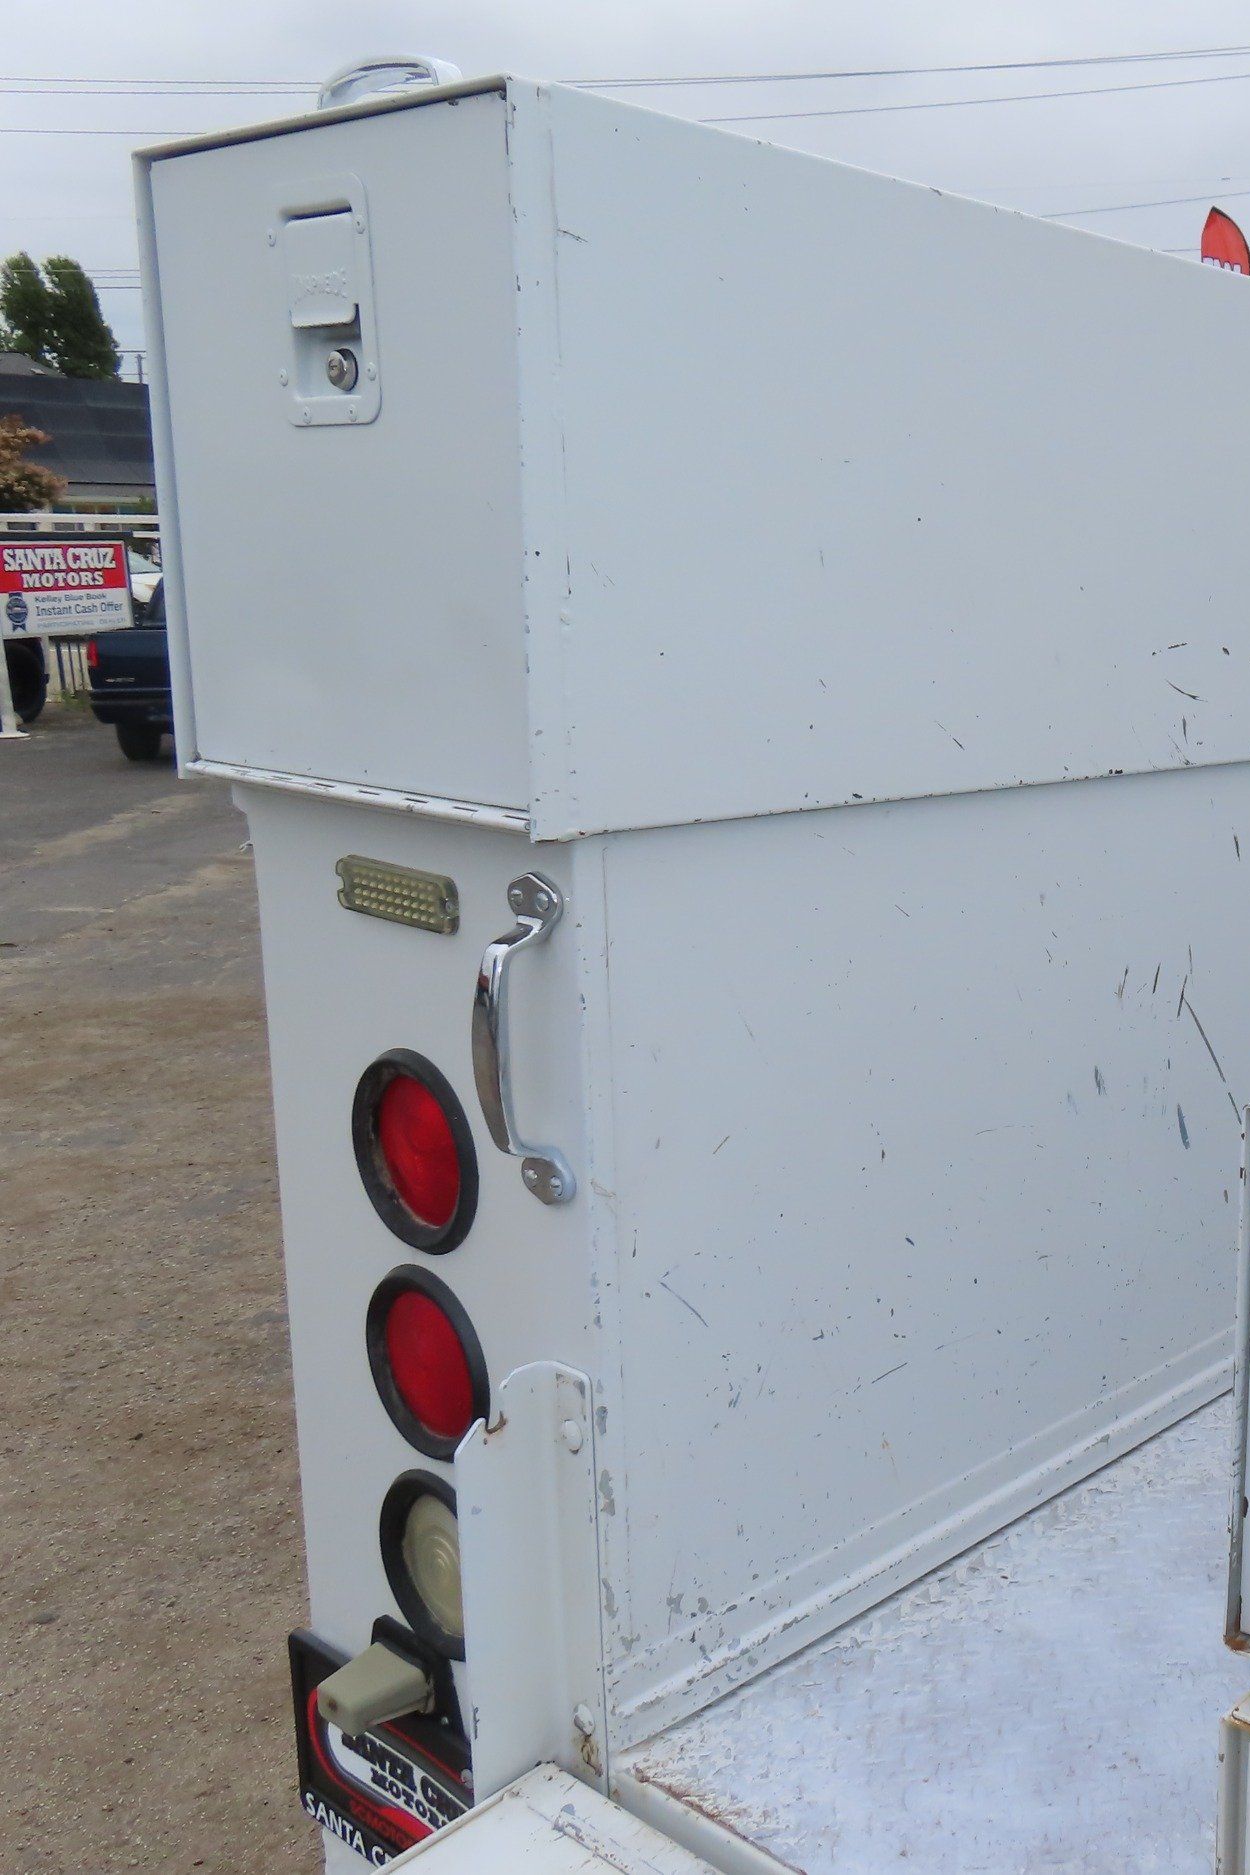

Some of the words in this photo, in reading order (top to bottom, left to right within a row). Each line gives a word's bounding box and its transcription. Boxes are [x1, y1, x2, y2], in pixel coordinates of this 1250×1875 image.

[2, 547, 67, 571] SANTA
[67, 547, 116, 569] CRUZ
[21, 571, 104, 588] MOTORS
[35, 595, 62, 604] Kelley
[65, 594, 84, 602] Blue
[35, 604, 72, 616] Instant
[75, 603, 98, 614] Cash
[101, 602, 123, 612] Offer
[305, 1792, 367, 1857] SANTA
